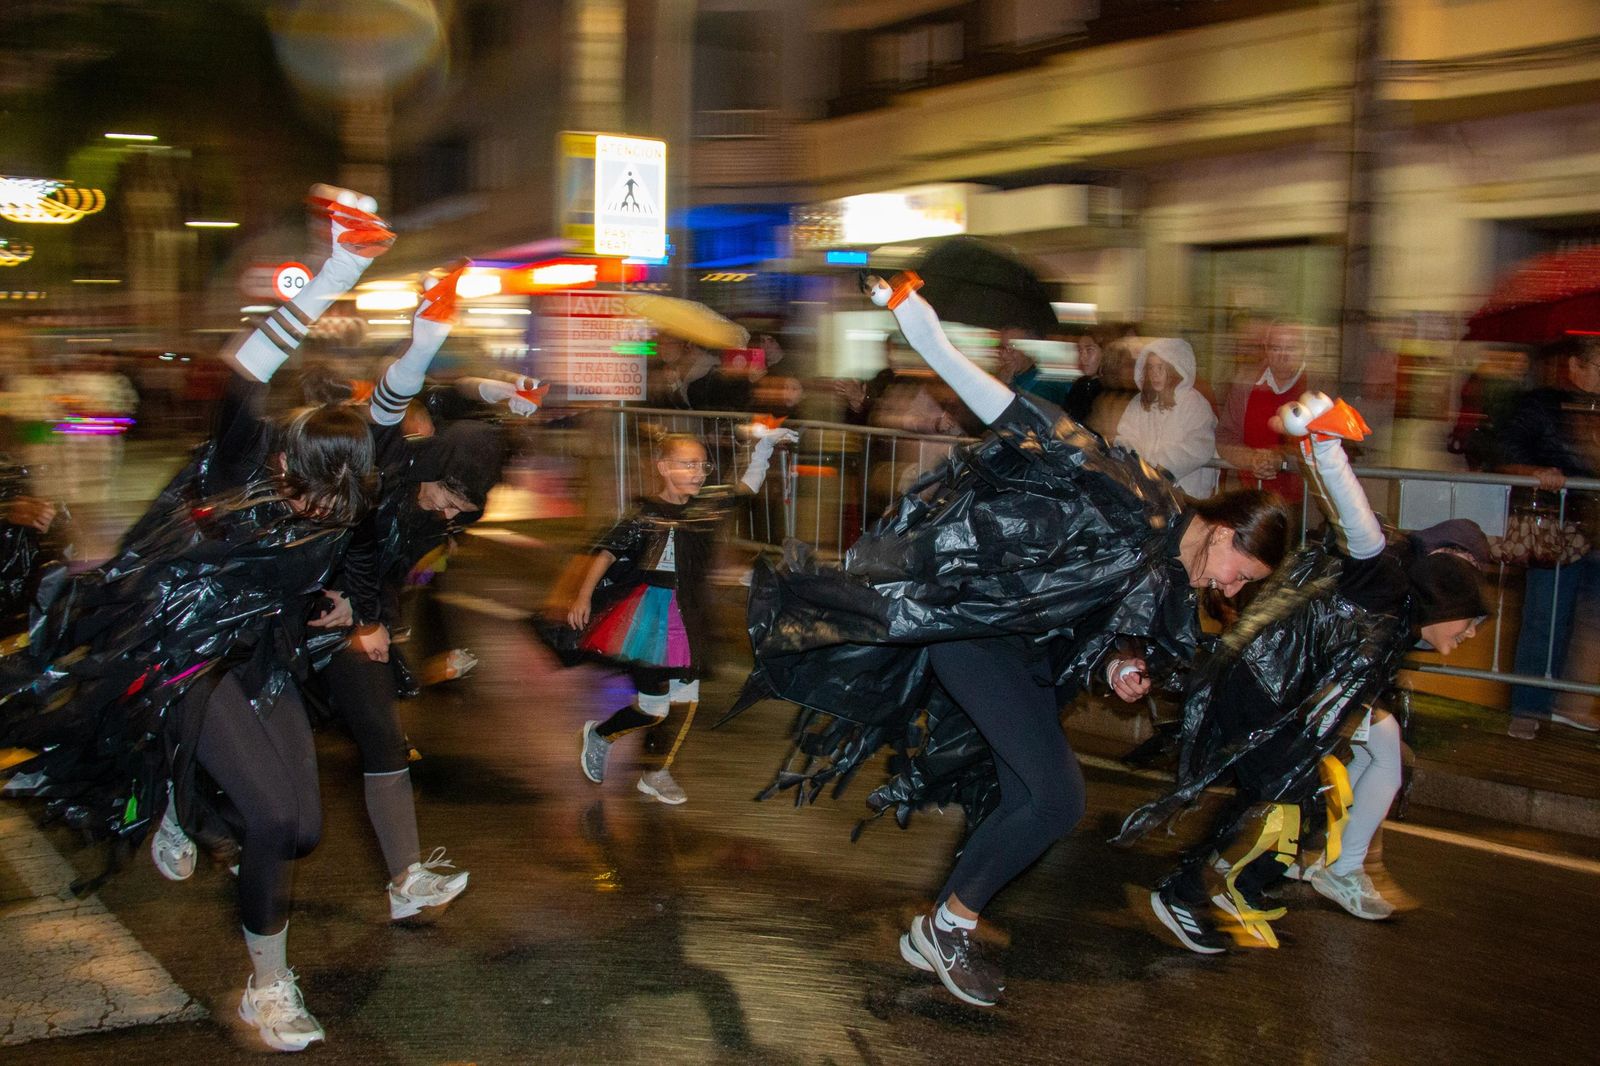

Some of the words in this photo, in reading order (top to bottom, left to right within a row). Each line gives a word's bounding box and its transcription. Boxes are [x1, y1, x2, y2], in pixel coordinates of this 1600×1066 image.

[284, 276, 304, 288] 30
[575, 296, 643, 315] AVISO
[582, 320, 633, 330] PRUEBA
[573, 373, 642, 384] CORTADO
[576, 386, 602, 395] 17:00
[614, 386, 642, 395] 21:00
